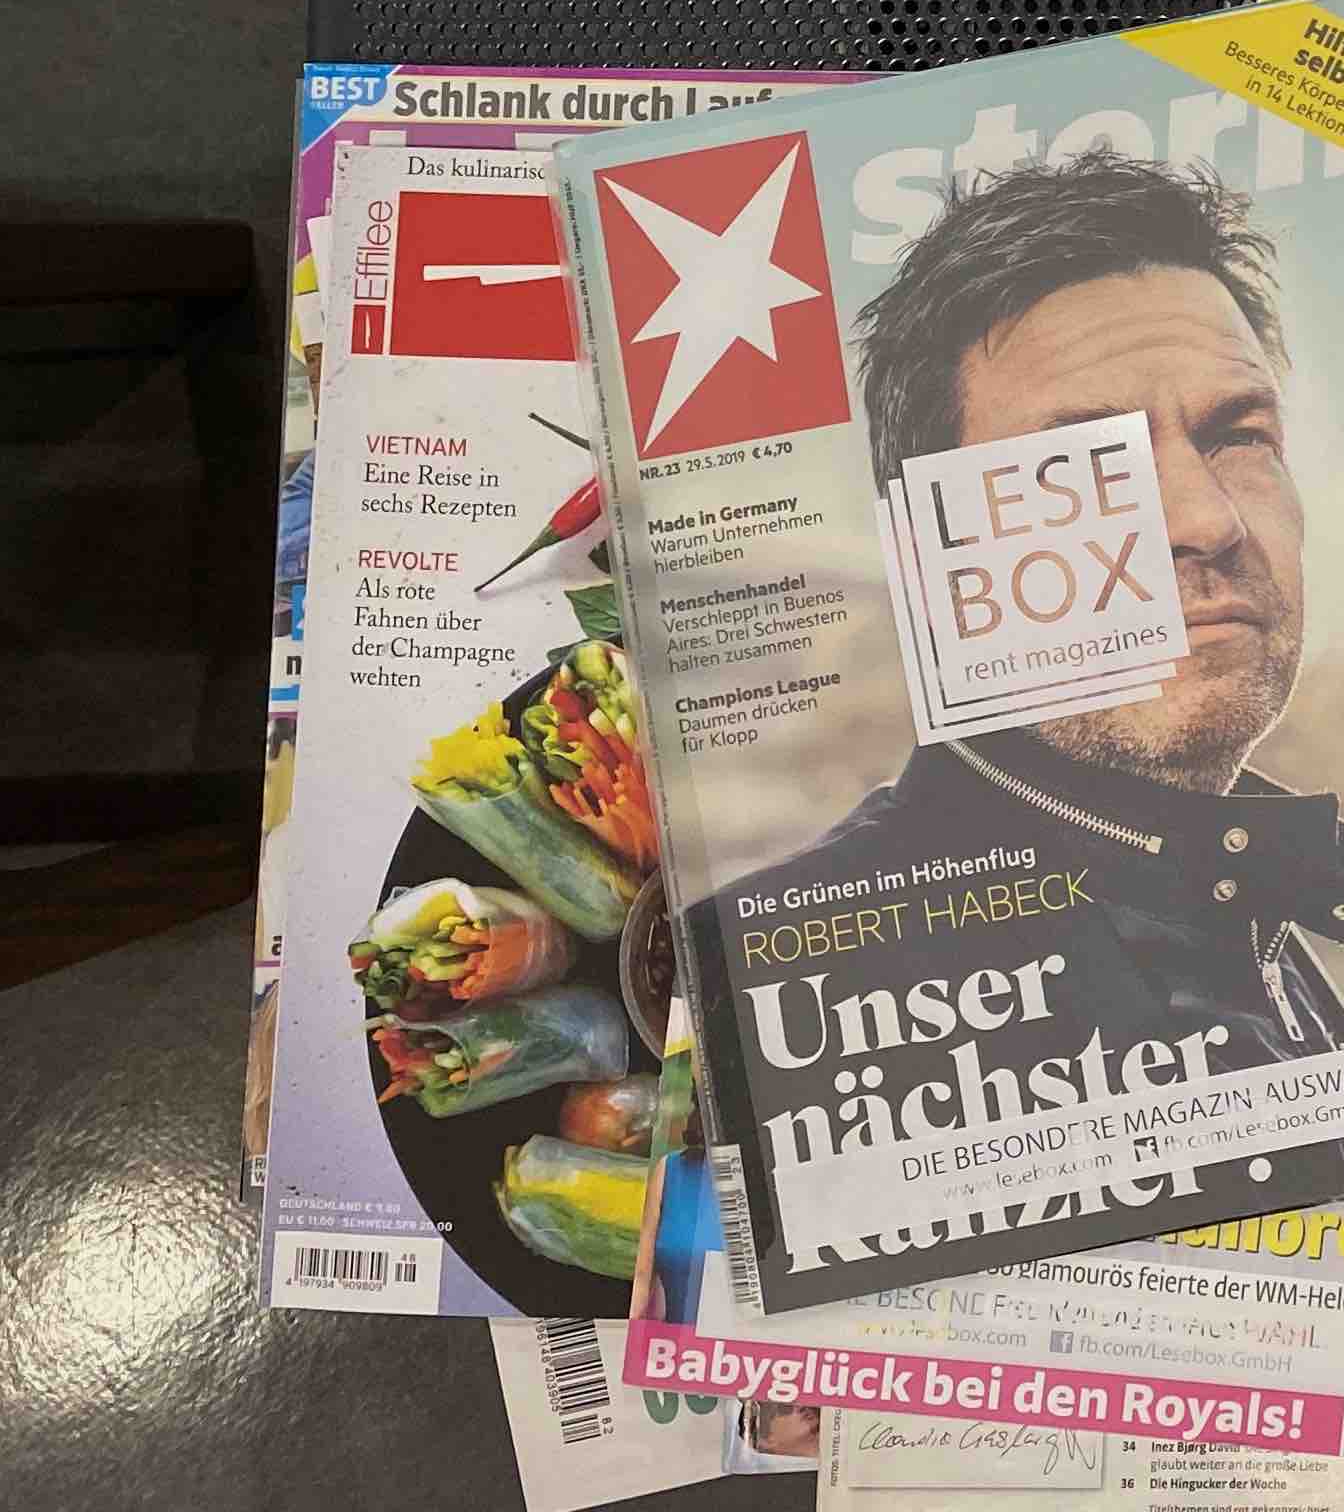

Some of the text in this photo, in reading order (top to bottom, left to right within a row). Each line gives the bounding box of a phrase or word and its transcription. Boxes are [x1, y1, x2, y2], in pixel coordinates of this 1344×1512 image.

[393, 81, 674, 120] Schlank durch
[353, 200, 392, 300] Effilee
[364, 464, 500, 488] Eine Reise in
[366, 435, 467, 457] VIETNAM
[930, 442, 1140, 550] LESE
[362, 495, 517, 522] sechs Rezepten
[947, 531, 1154, 641] BOX
[738, 846, 1037, 919] Die Grünen im Höhenflug
[742, 868, 1094, 968] ROBERT HABECK
[742, 953, 1066, 1071] Unser
[645, 1338, 1305, 1441] Babyglück bei den Royals!
